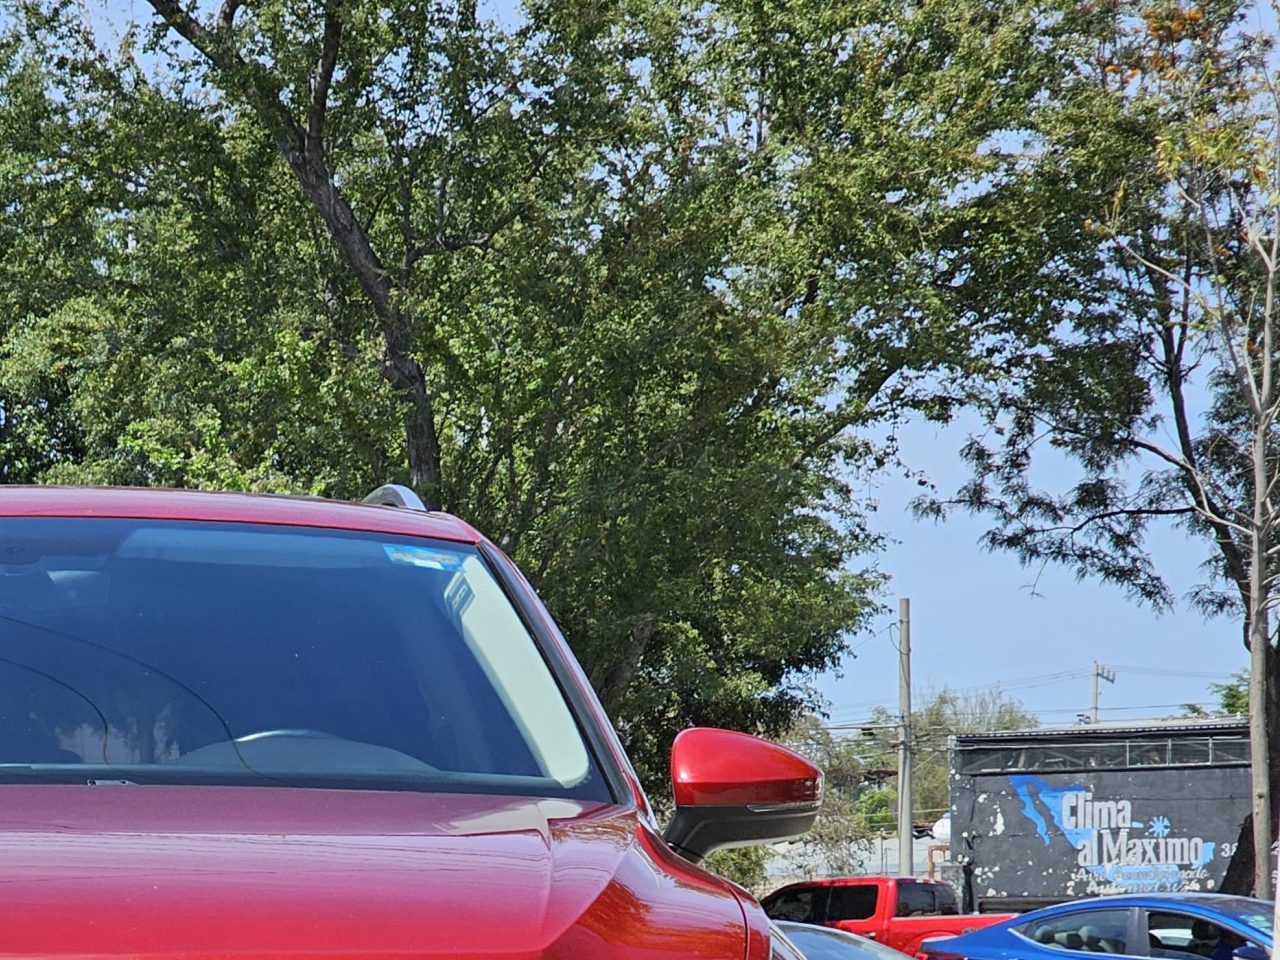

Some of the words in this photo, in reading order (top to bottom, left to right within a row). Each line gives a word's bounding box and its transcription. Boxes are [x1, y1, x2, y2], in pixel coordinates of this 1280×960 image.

[1062, 791, 1132, 829] Clima
[1077, 829, 1098, 867] al
[1100, 829, 1203, 867] Maximo
